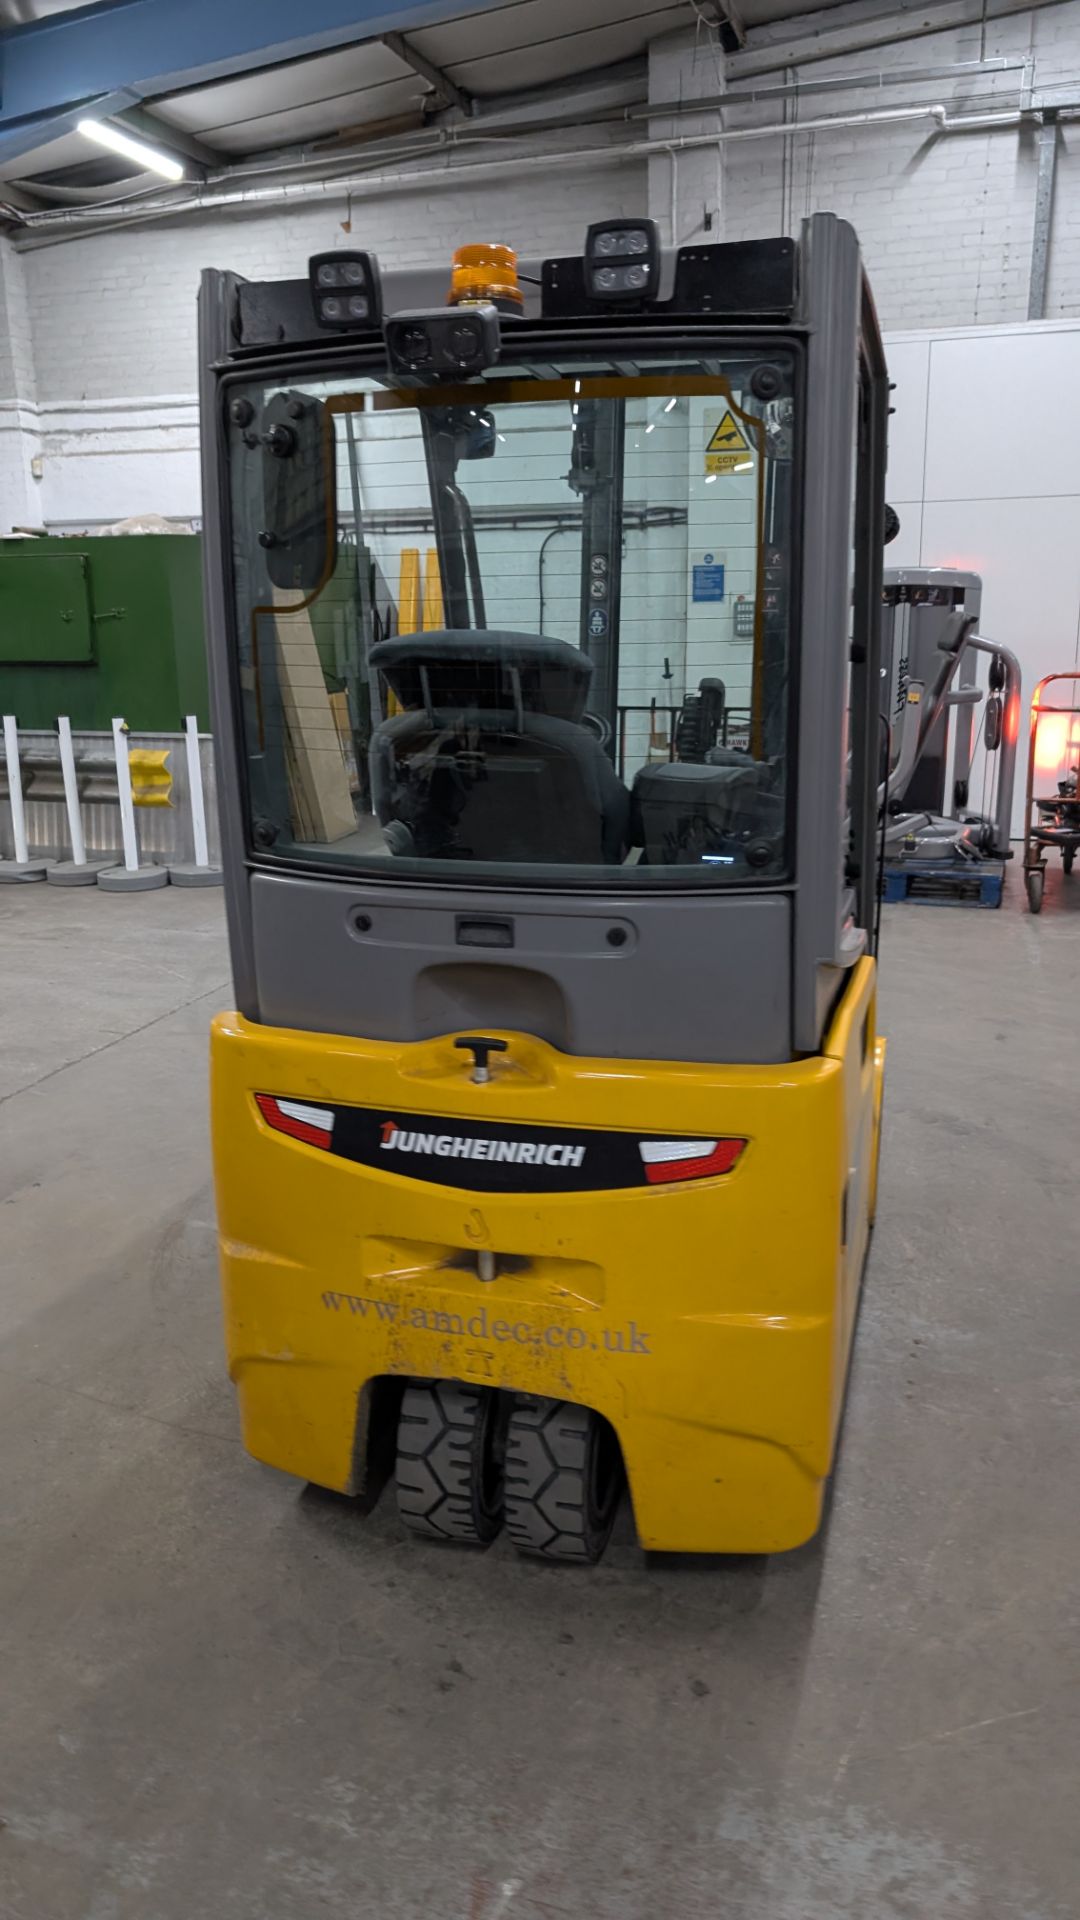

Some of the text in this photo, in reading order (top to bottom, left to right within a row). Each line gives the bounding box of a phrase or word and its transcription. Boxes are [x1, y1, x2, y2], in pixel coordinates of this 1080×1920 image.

[717, 456, 738, 464] CCTV
[380, 1129, 586, 1167] JUNGHEINRICH
[321, 1291, 651, 1355] www.amdec.co.uk
